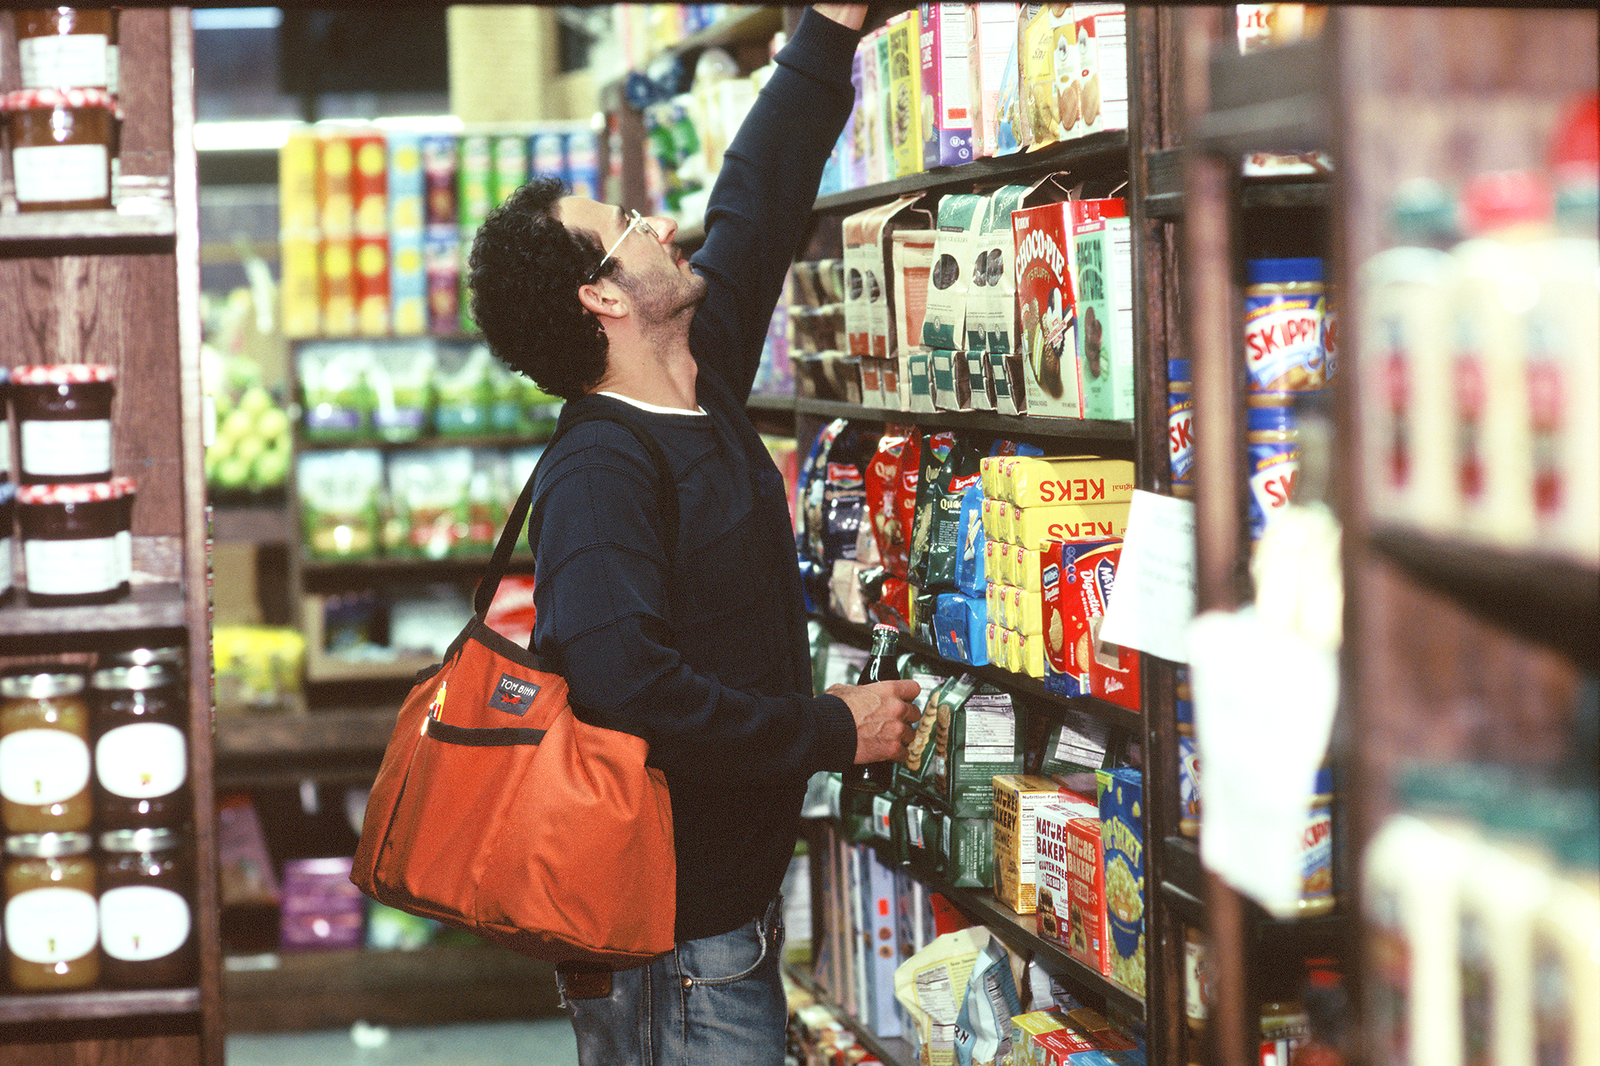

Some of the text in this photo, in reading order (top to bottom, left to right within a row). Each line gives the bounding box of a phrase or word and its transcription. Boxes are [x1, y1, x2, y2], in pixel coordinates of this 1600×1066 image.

[1039, 478, 1105, 503] KEKS
[500, 678, 537, 697] TOM BIHN
